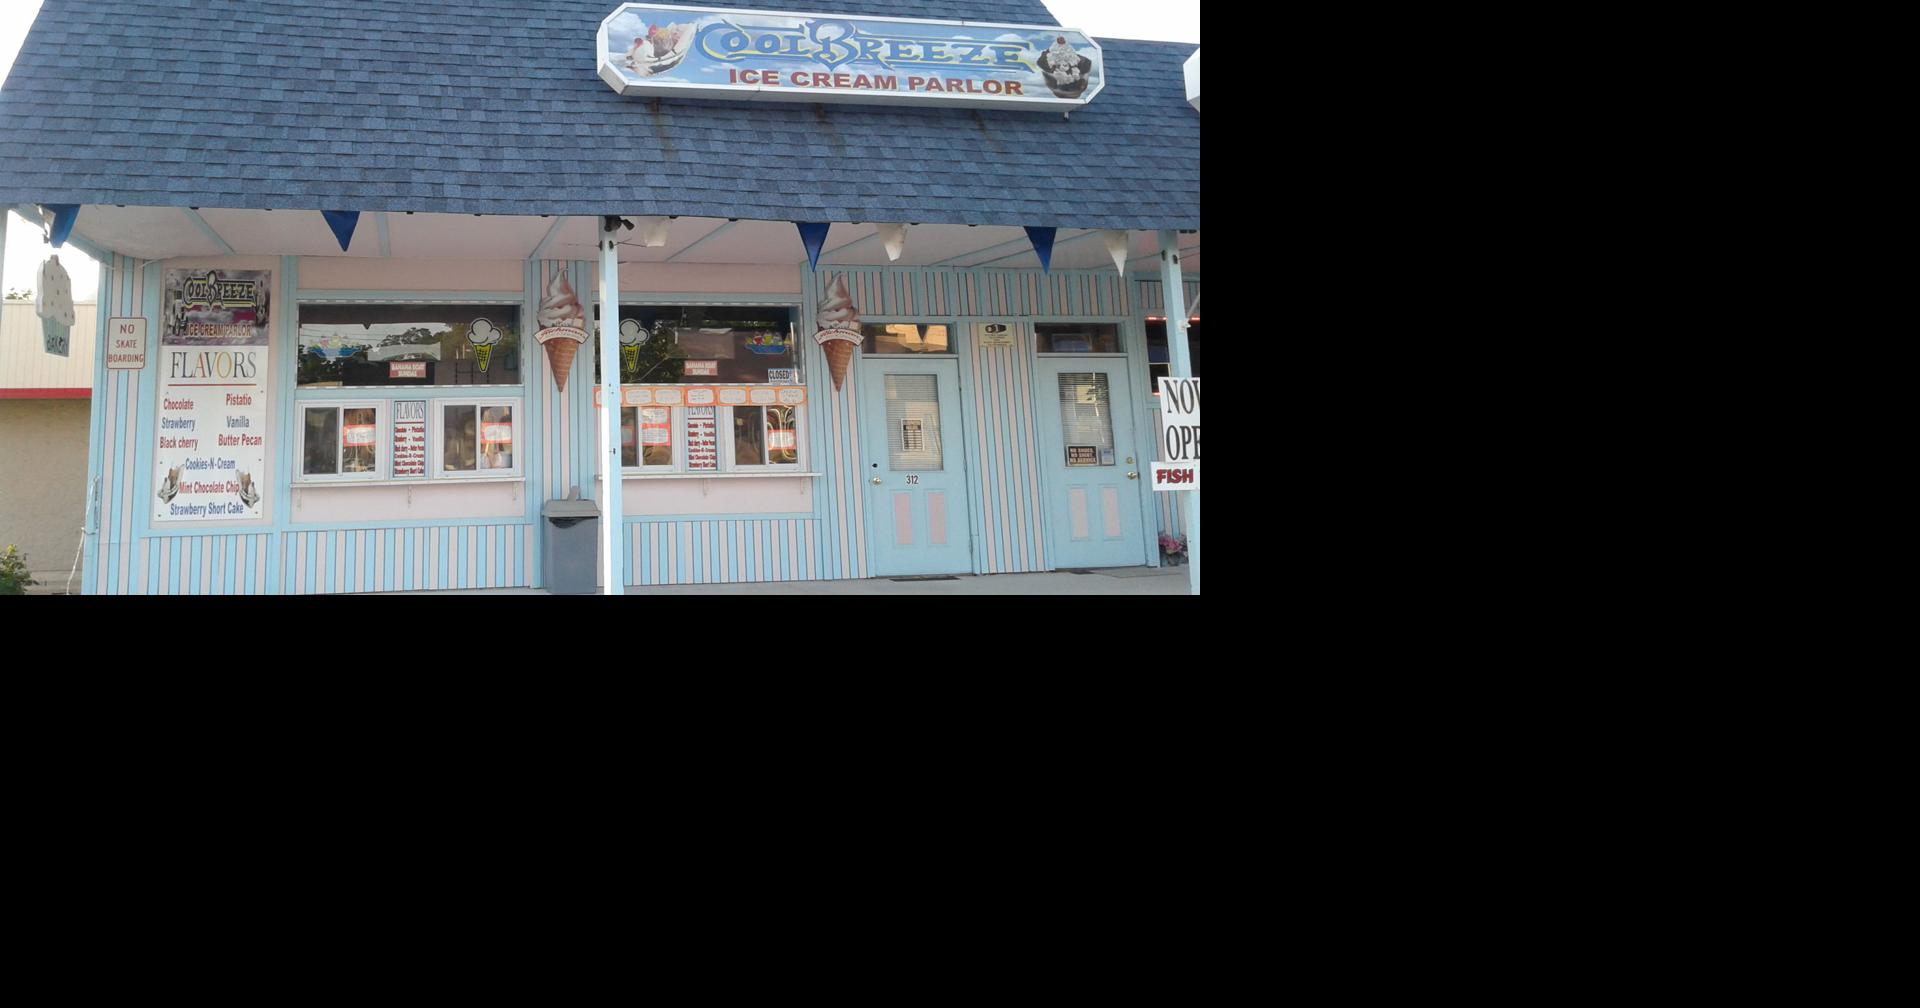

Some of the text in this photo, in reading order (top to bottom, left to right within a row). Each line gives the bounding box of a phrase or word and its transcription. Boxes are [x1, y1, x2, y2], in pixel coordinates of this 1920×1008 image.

[729, 68, 1024, 95] ICE CREAM PARLOR
[120, 324, 135, 334] NO
[200, 324, 224, 337] CREAM
[225, 324, 252, 337] PARLOR
[115, 339, 137, 349] SKATE
[108, 353, 144, 363] BOARDING
[170, 351, 257, 378] FLAVORS
[769, 370, 790, 380] CLOSED
[163, 398, 194, 410] Chocolate
[226, 393, 252, 406] Pistatio
[396, 402, 424, 419] FLAVORS
[161, 417, 196, 431] Strawberry
[226, 416, 250, 428] Vanilla
[160, 436, 199, 451] Black cherry
[218, 433, 263, 446] Butter Pecan
[906, 475, 919, 485] 312
[1156, 468, 1194, 484] FISH
[179, 480, 240, 496] Mint Chocolate Chip
[170, 502, 244, 517] Strawberry Short Cake
